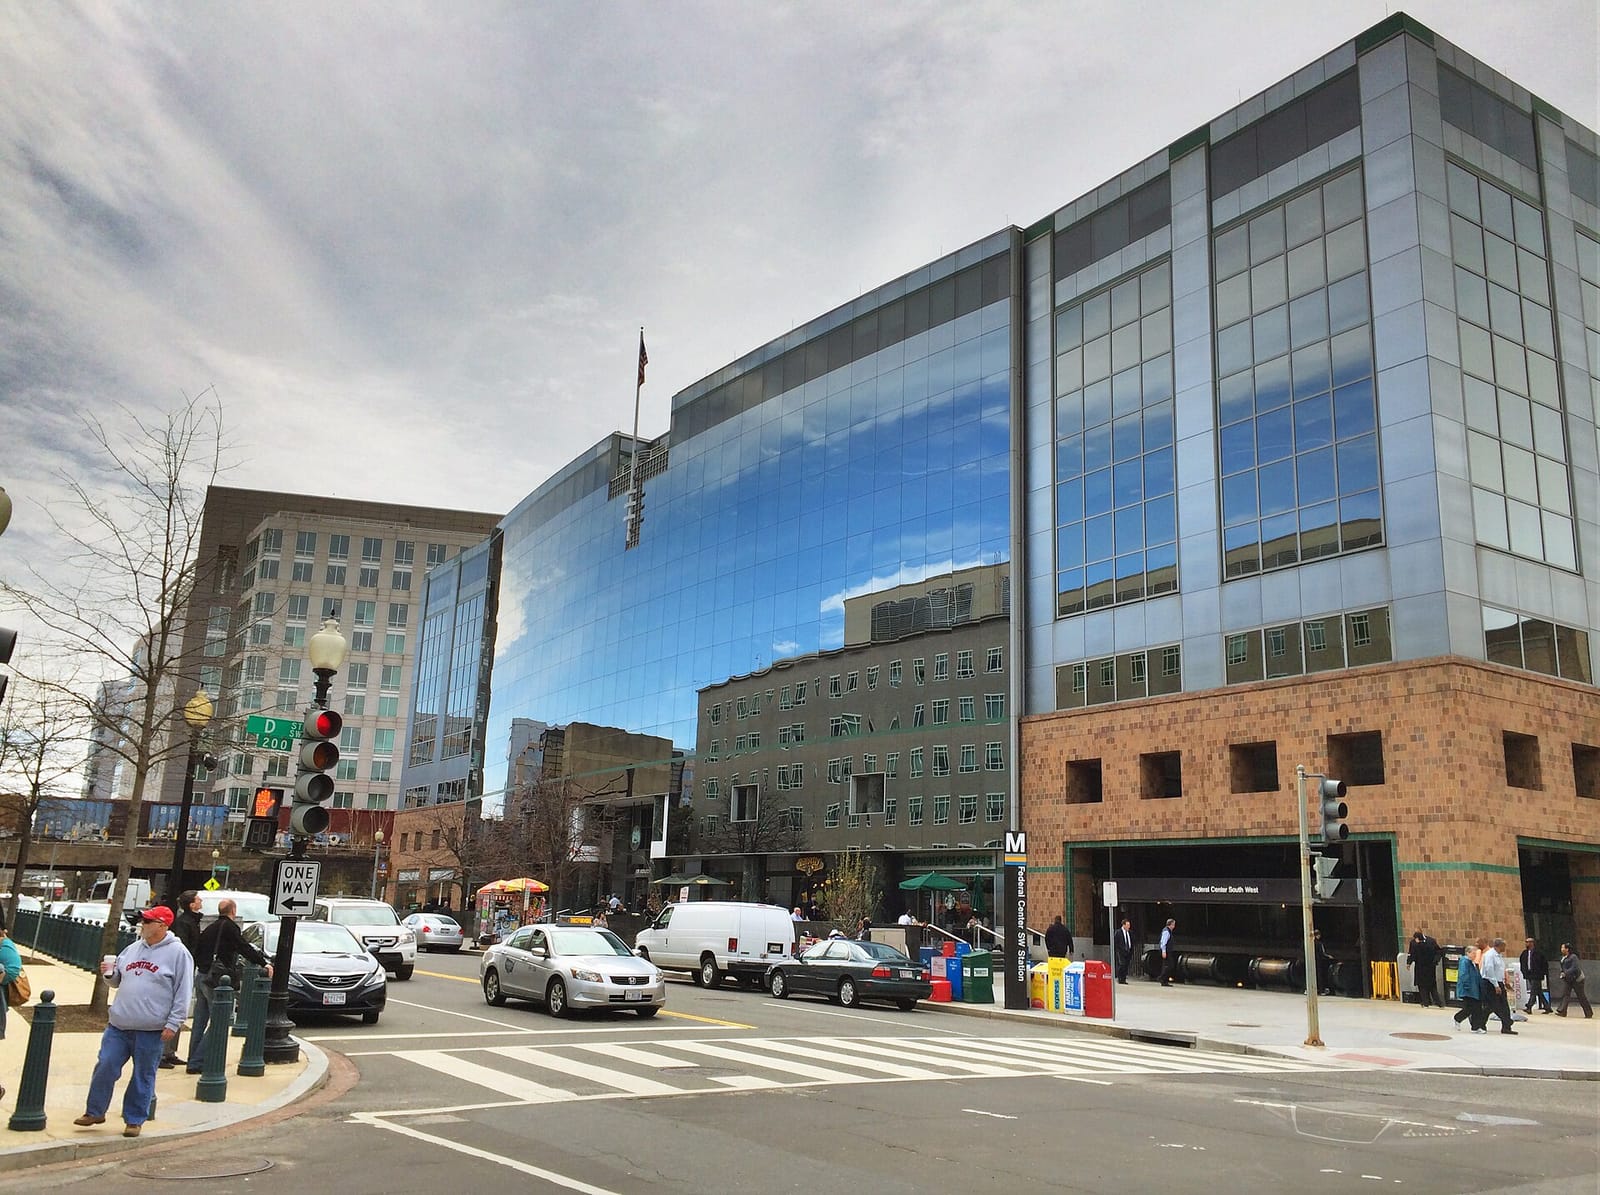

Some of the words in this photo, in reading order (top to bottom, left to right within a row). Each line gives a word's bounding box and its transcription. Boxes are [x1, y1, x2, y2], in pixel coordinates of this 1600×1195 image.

[264, 719, 276, 734] D
[262, 737, 288, 750] 200
[160, 806, 213, 816] Boon
[1005, 832, 1026, 853] M
[285, 866, 315, 879] ONE
[282, 881, 314, 895] WAY
[1017, 866, 1026, 897] Federal
[1244, 886, 1259, 894] West
[1017, 900, 1026, 929] Center
[1017, 932, 1026, 947] SW
[1017, 950, 1026, 982] Station
